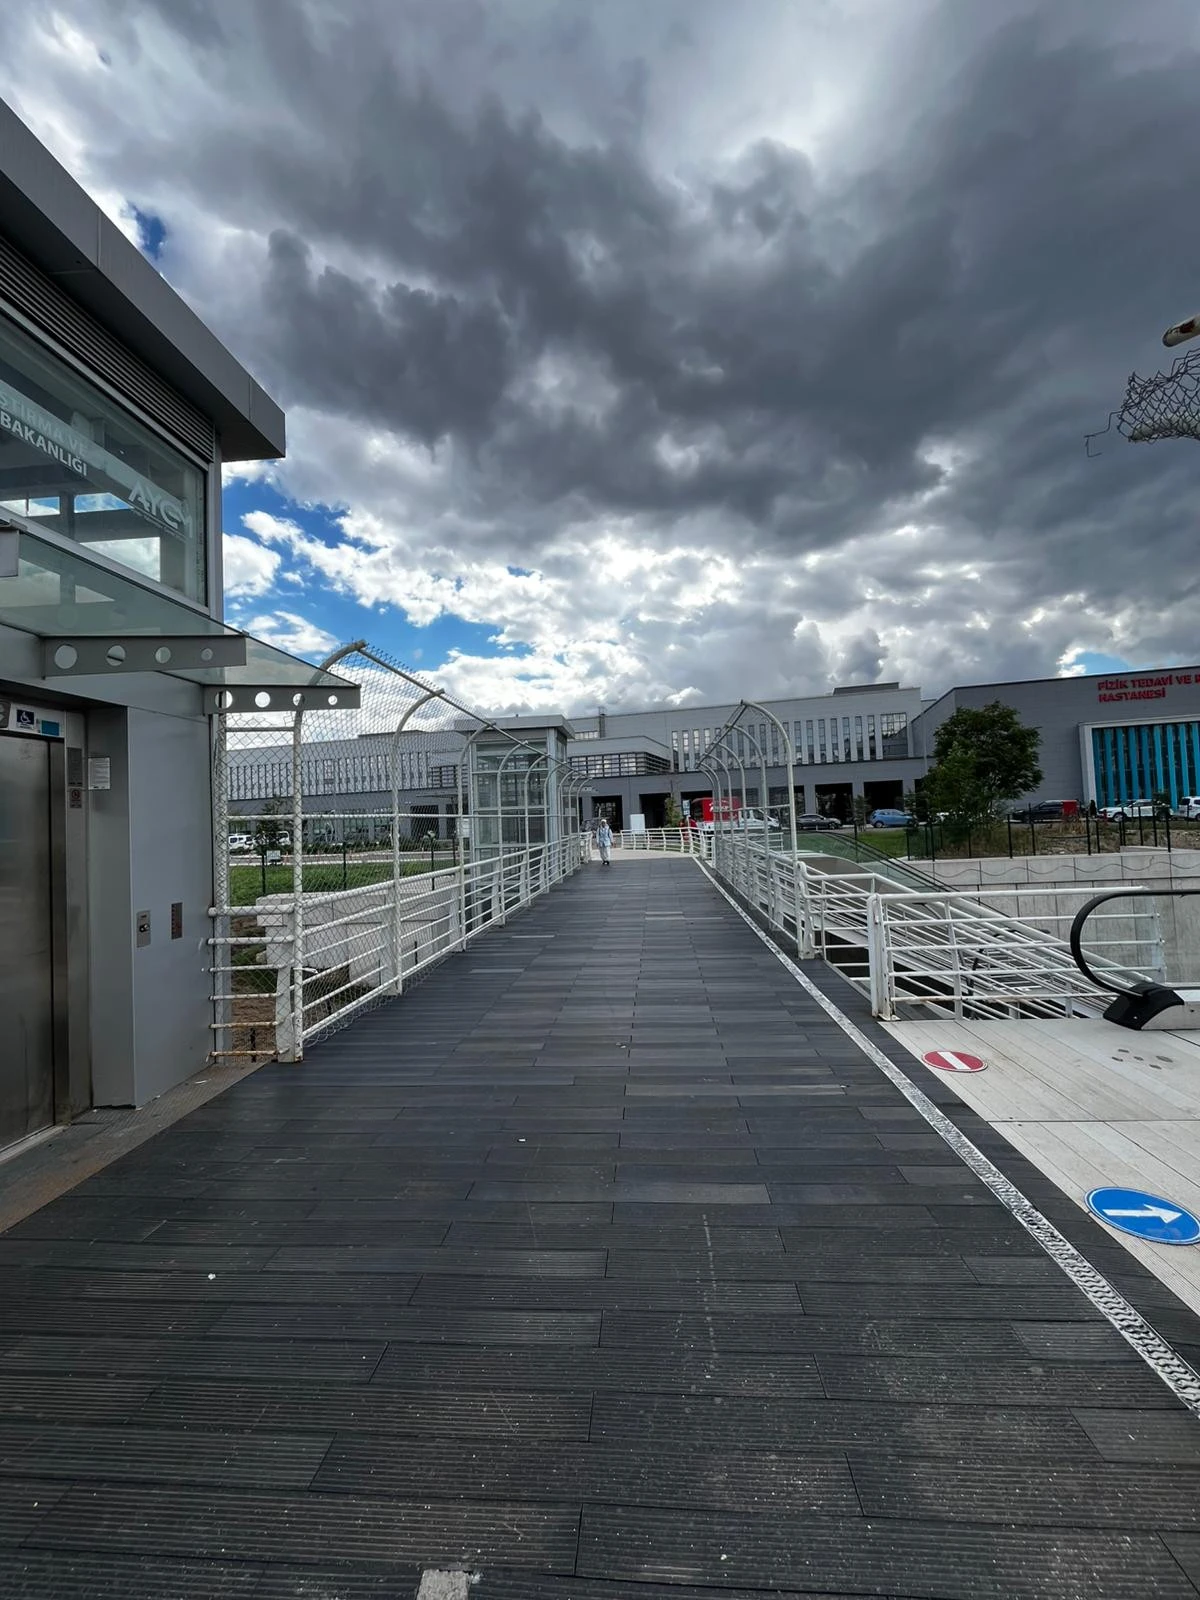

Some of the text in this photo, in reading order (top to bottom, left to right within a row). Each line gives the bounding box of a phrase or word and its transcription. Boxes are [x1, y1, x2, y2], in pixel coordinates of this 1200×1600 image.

[0, 411, 88, 476] BAKANLIĞI
[1097, 678, 1128, 691] FİZİK
[1130, 674, 1172, 689] TEDAVİ
[1176, 674, 1192, 685] VE
[1098, 687, 1166, 703] HASTANESİ
